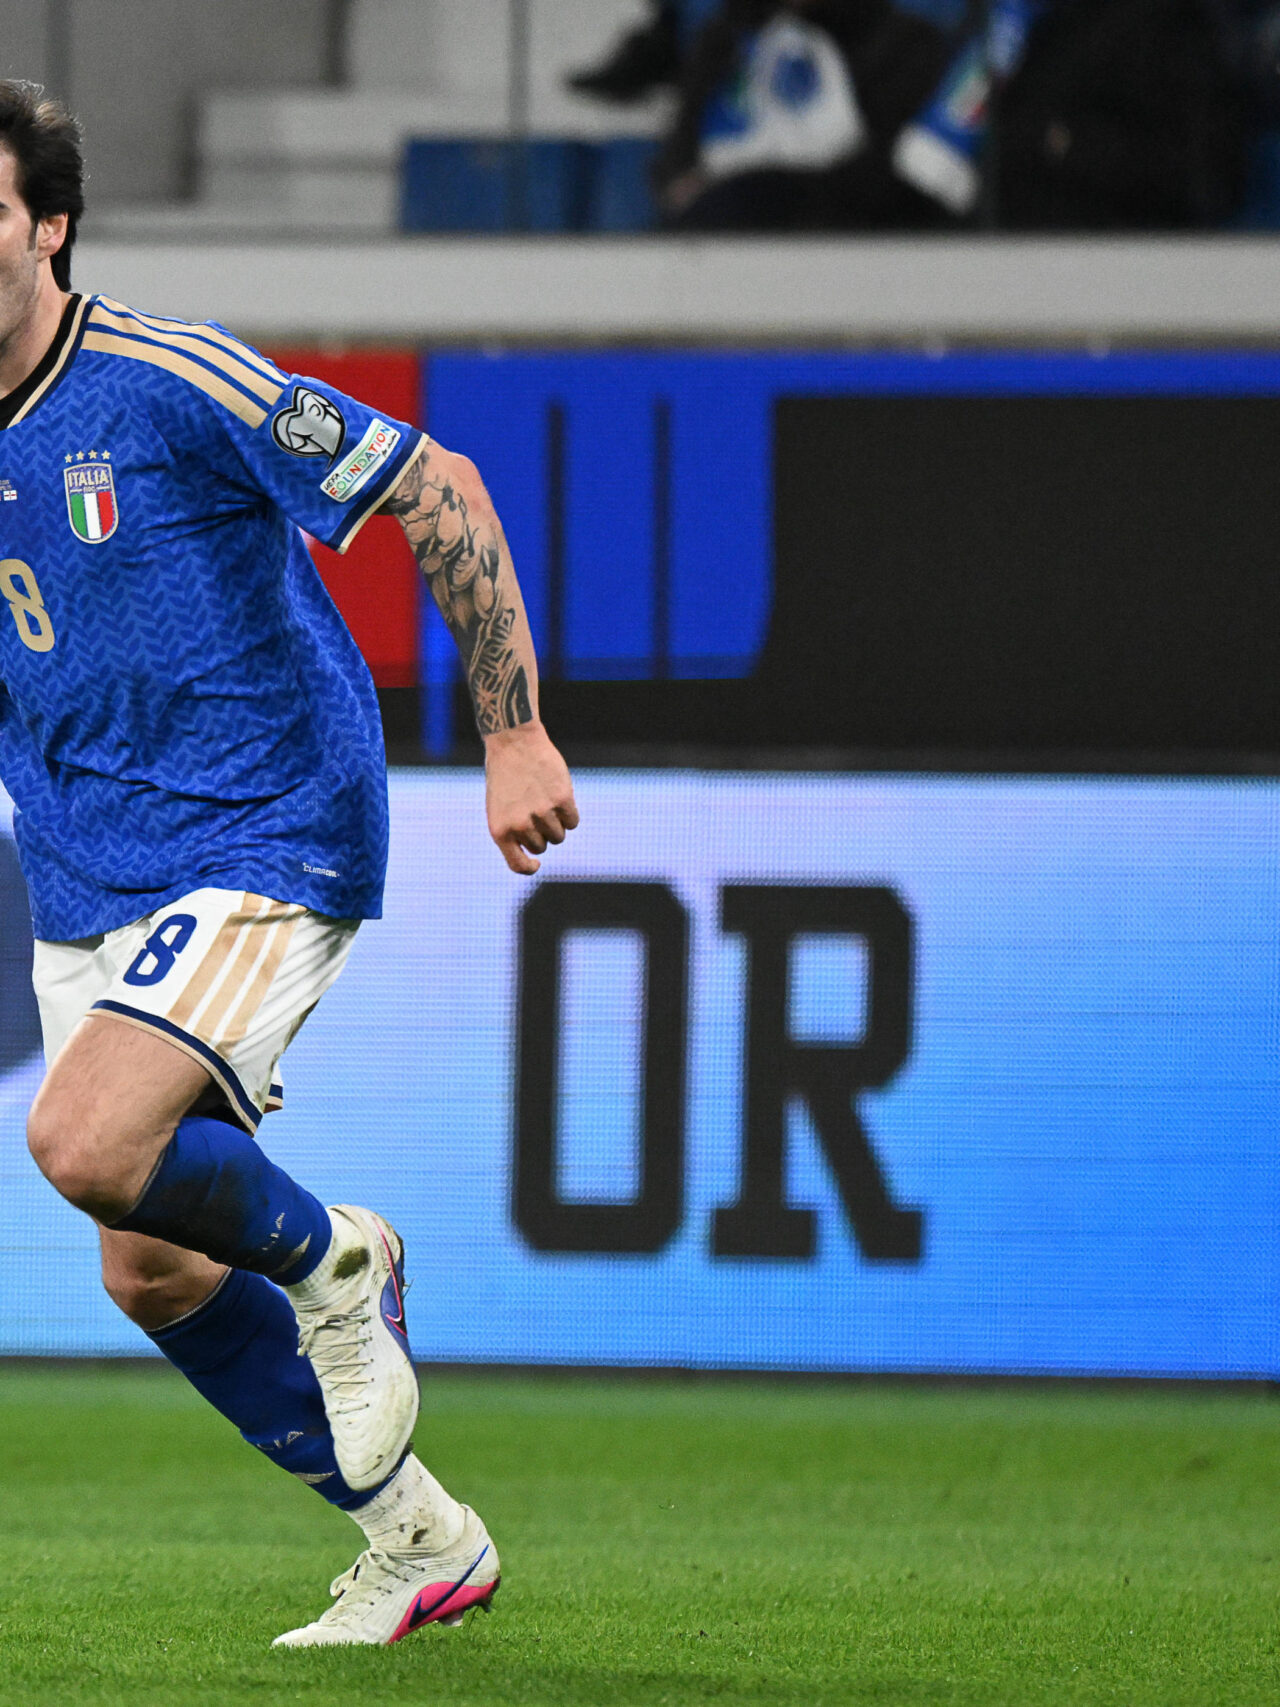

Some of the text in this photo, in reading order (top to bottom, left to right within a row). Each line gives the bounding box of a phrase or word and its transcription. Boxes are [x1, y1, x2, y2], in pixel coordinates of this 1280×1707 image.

[68, 469, 109, 487] ITALIA
[329, 425, 391, 498] FOUNDATION
[123, 913, 198, 987] 8
[510, 879, 926, 1262] OR
